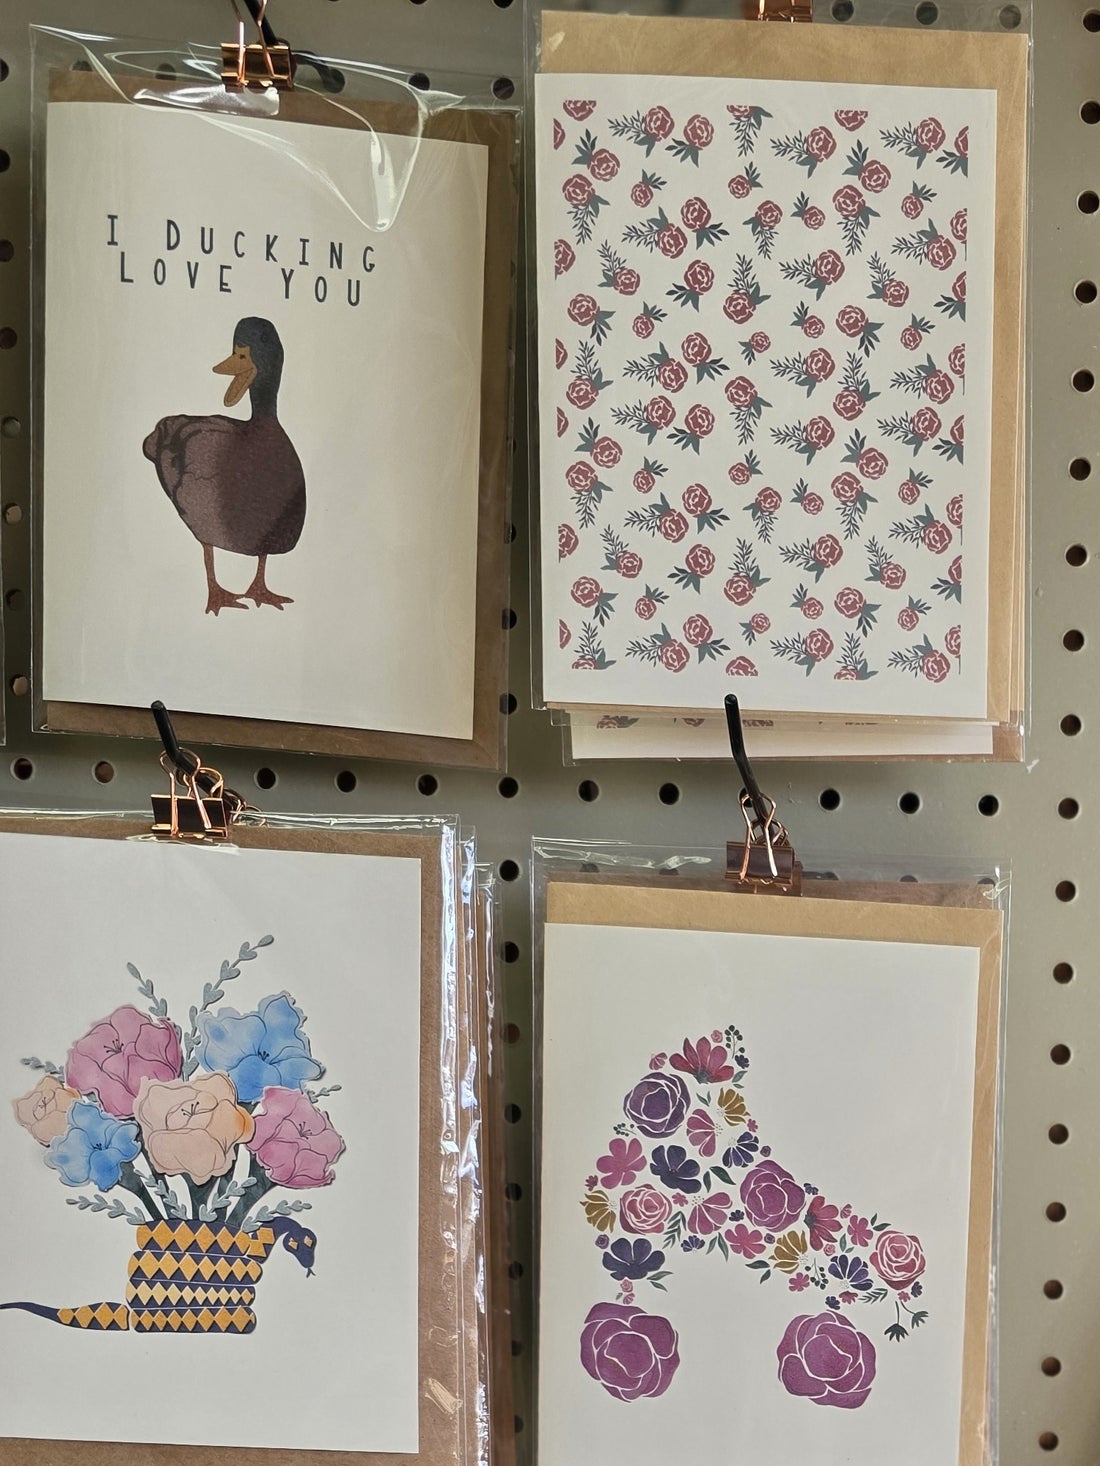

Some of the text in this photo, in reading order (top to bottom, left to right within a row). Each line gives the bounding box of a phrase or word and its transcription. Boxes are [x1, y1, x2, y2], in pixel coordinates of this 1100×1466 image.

[106, 214, 376, 273] I DUCKING
[119, 251, 361, 307] LOVE YOU
